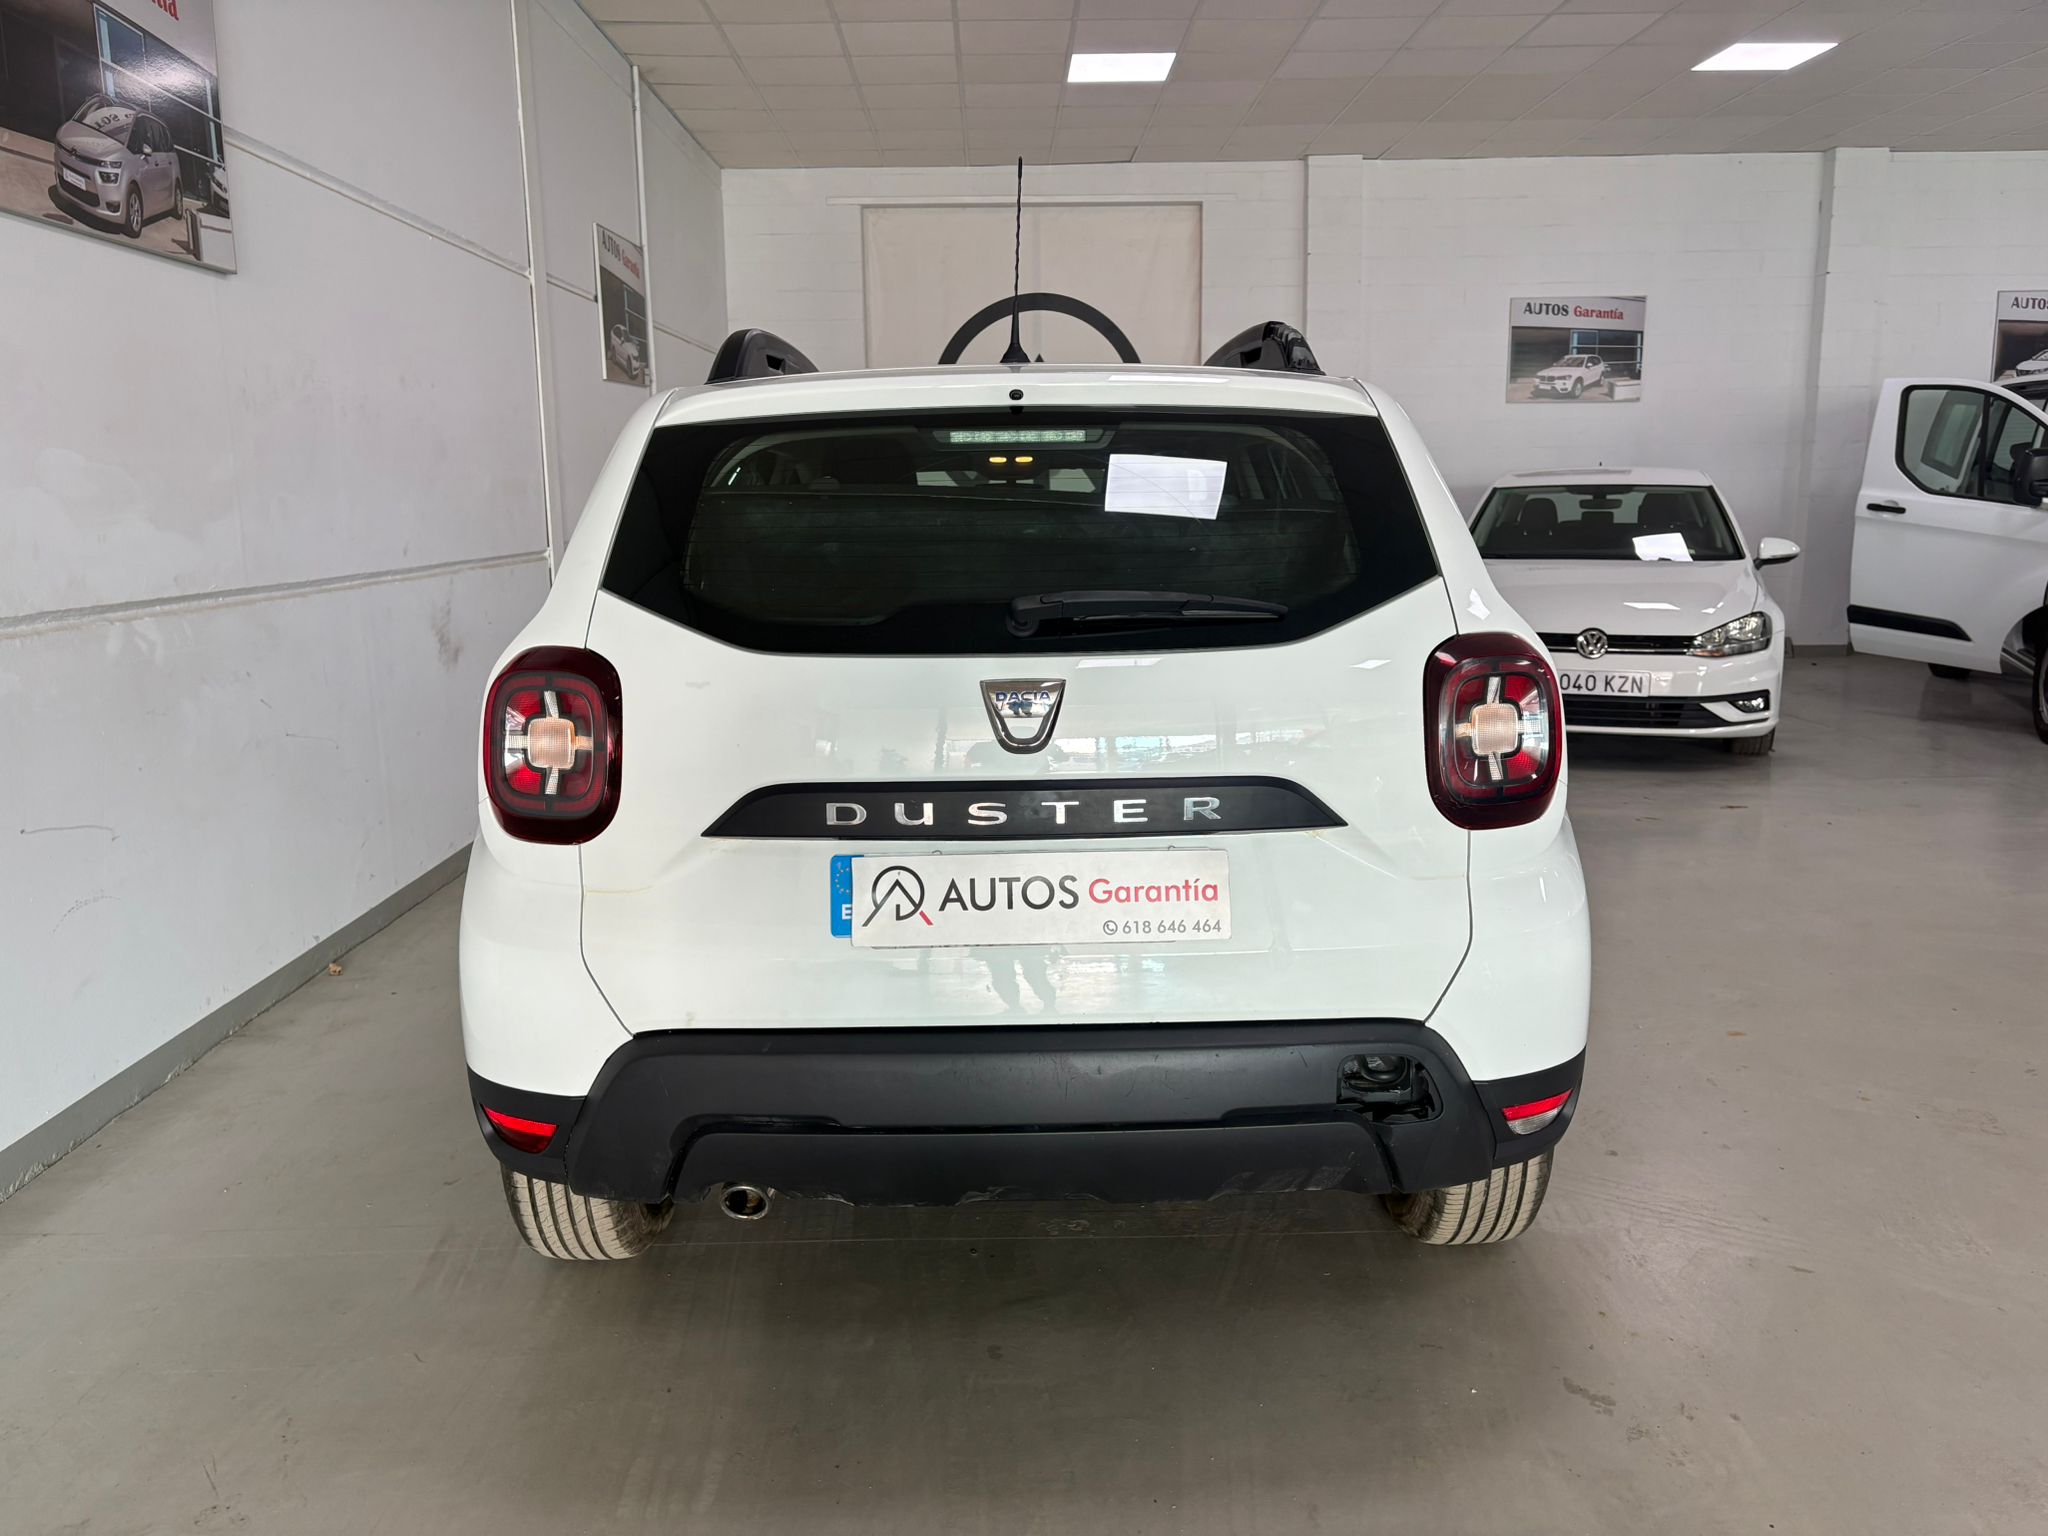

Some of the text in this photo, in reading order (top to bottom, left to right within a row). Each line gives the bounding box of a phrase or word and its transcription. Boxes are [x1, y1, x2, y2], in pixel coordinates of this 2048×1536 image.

[1523, 302, 1624, 320] AUTOS Garantía
[2011, 296, 2048, 310] AUTO
[1560, 673, 1643, 694] 040 KZN
[995, 691, 1051, 702] DACIA
[826, 796, 1222, 826] DUSTER
[938, 875, 1219, 911] AUTOS Garantía
[1122, 919, 1222, 935] 618 646 464
